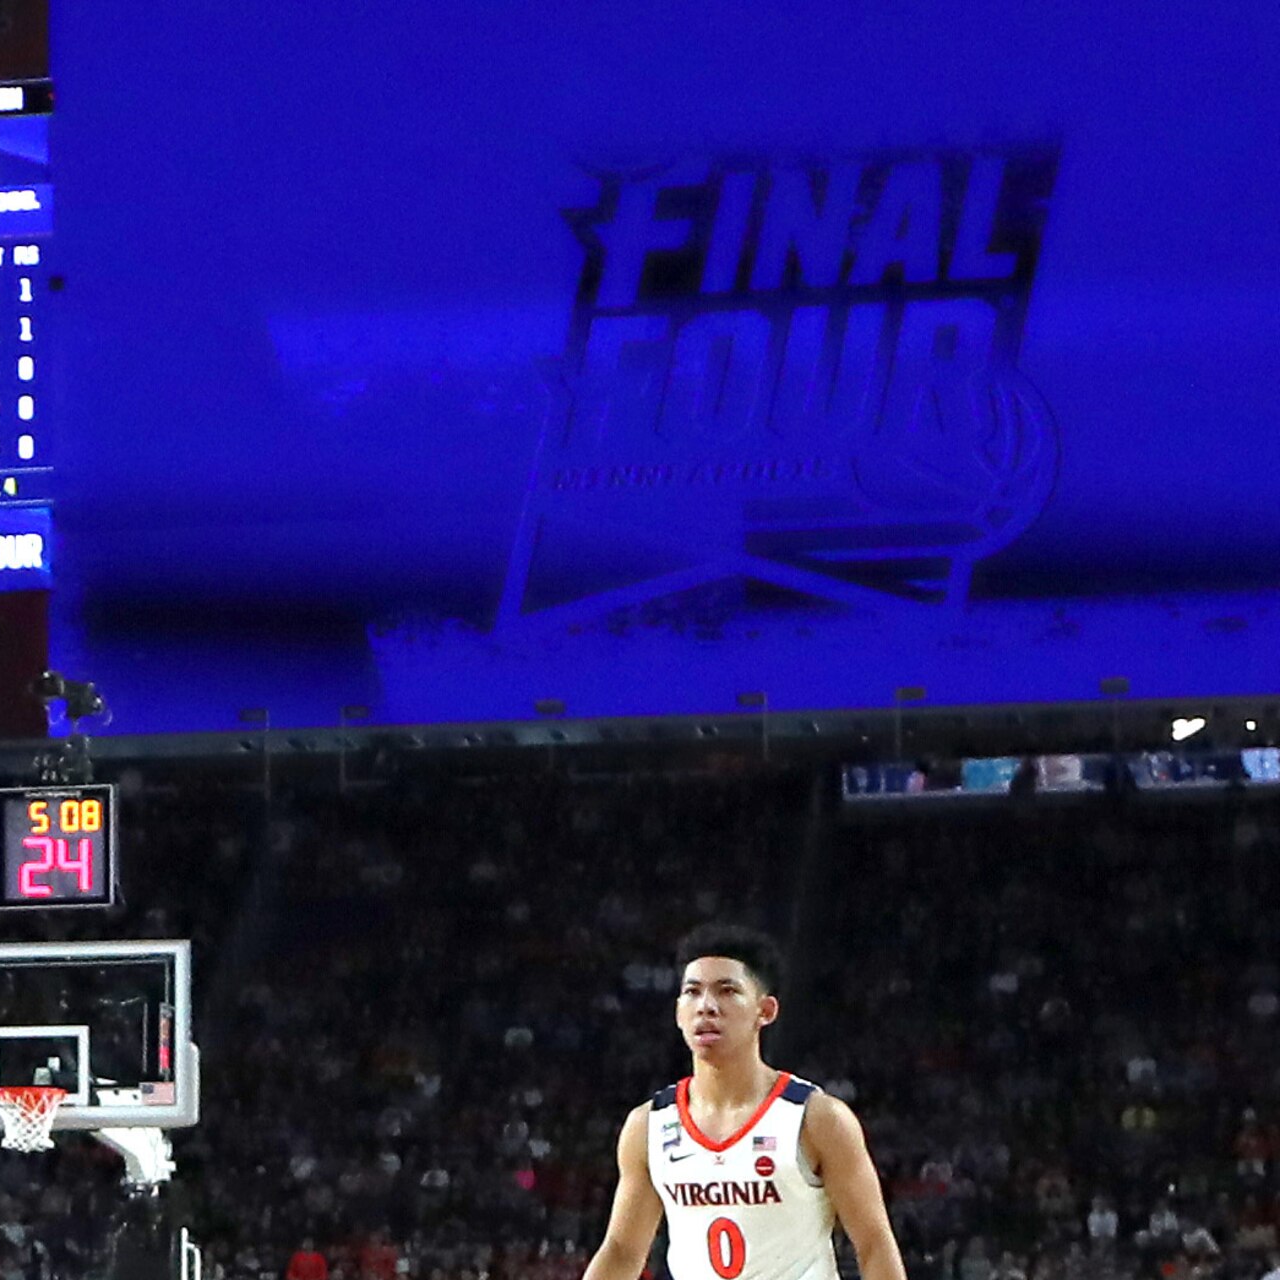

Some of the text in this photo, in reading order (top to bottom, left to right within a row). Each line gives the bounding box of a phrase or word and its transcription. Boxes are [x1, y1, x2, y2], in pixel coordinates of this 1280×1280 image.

[20, 278, 32, 302] 1
[20, 317, 32, 341] 1
[18, 836, 93, 899] 24
[664, 1180, 782, 1207] VIRGINIA
[707, 1216, 747, 1280] 0
